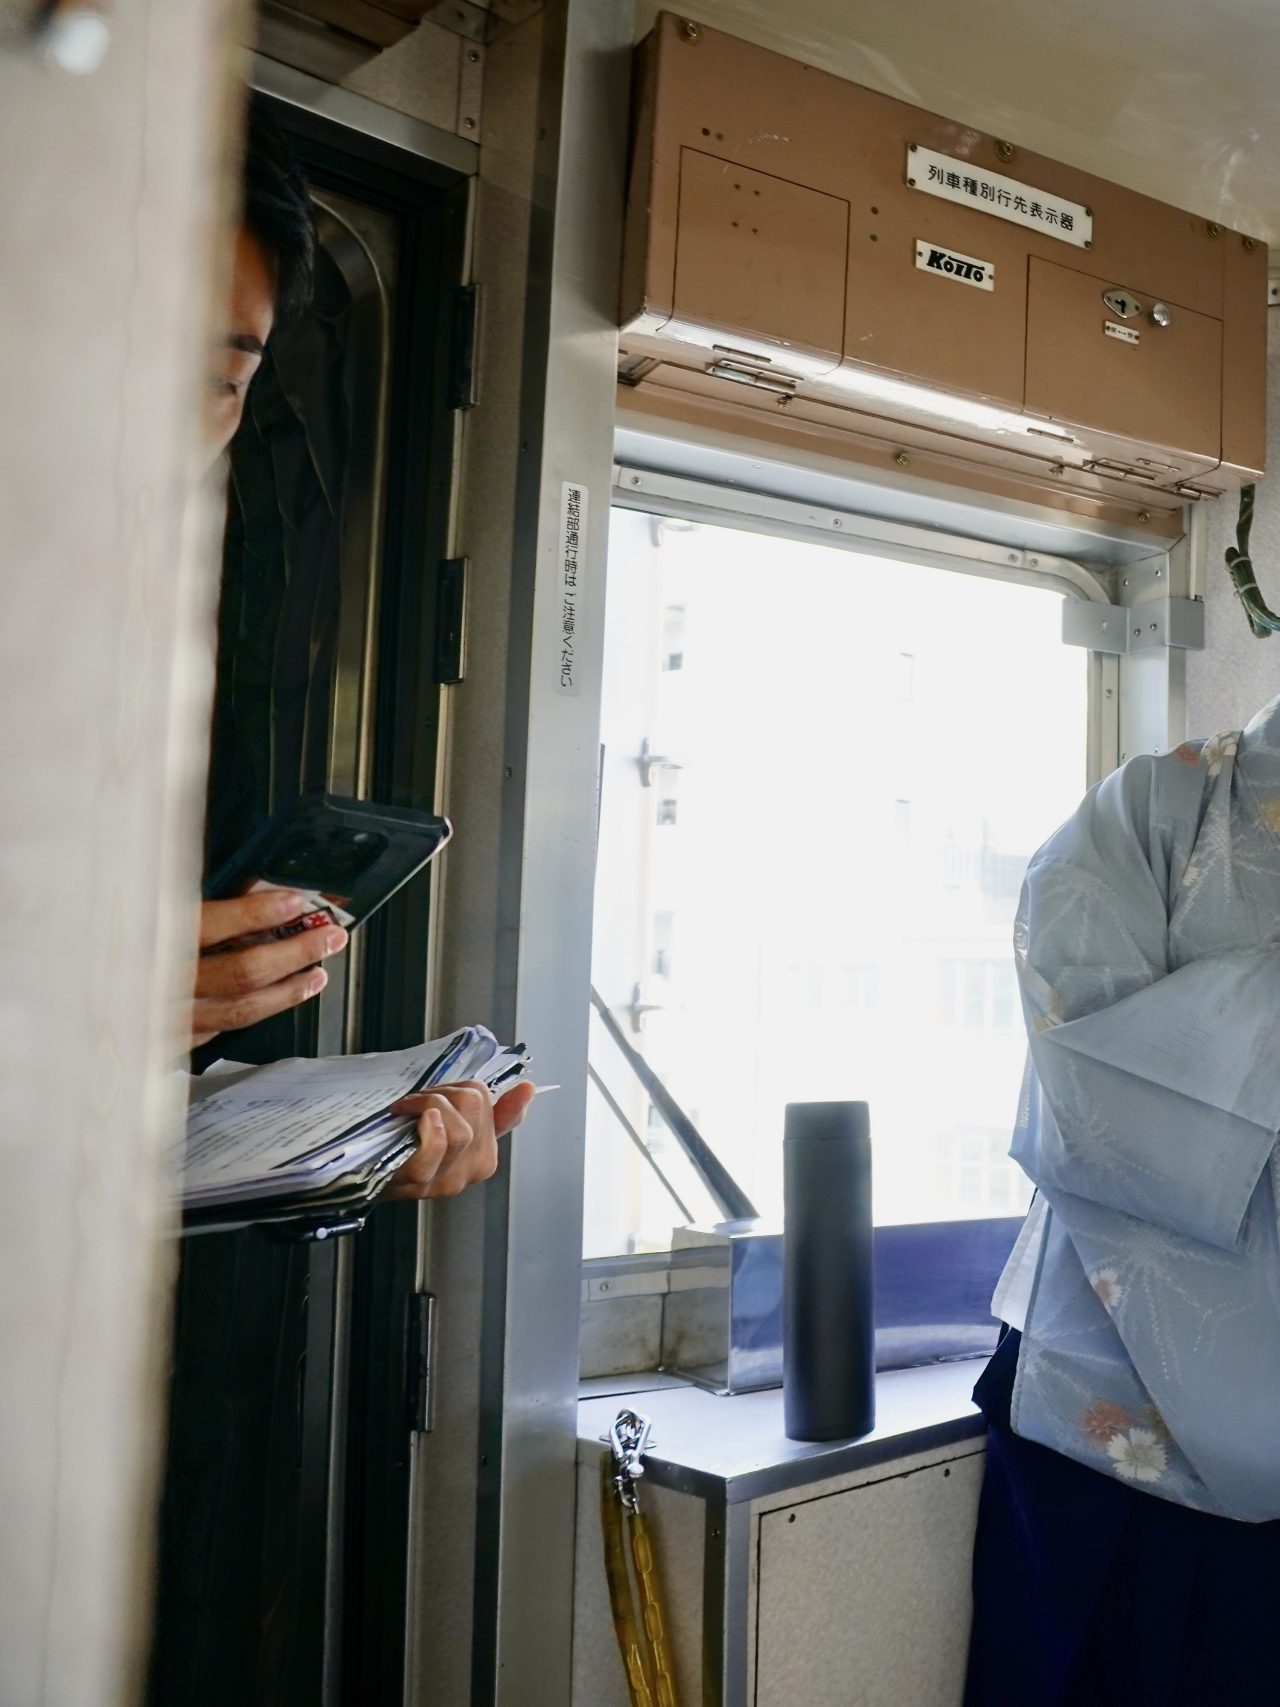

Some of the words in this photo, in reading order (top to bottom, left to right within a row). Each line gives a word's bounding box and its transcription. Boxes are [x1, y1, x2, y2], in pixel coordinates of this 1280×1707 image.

[928, 164, 1074, 231] 列車種別行先表示器
